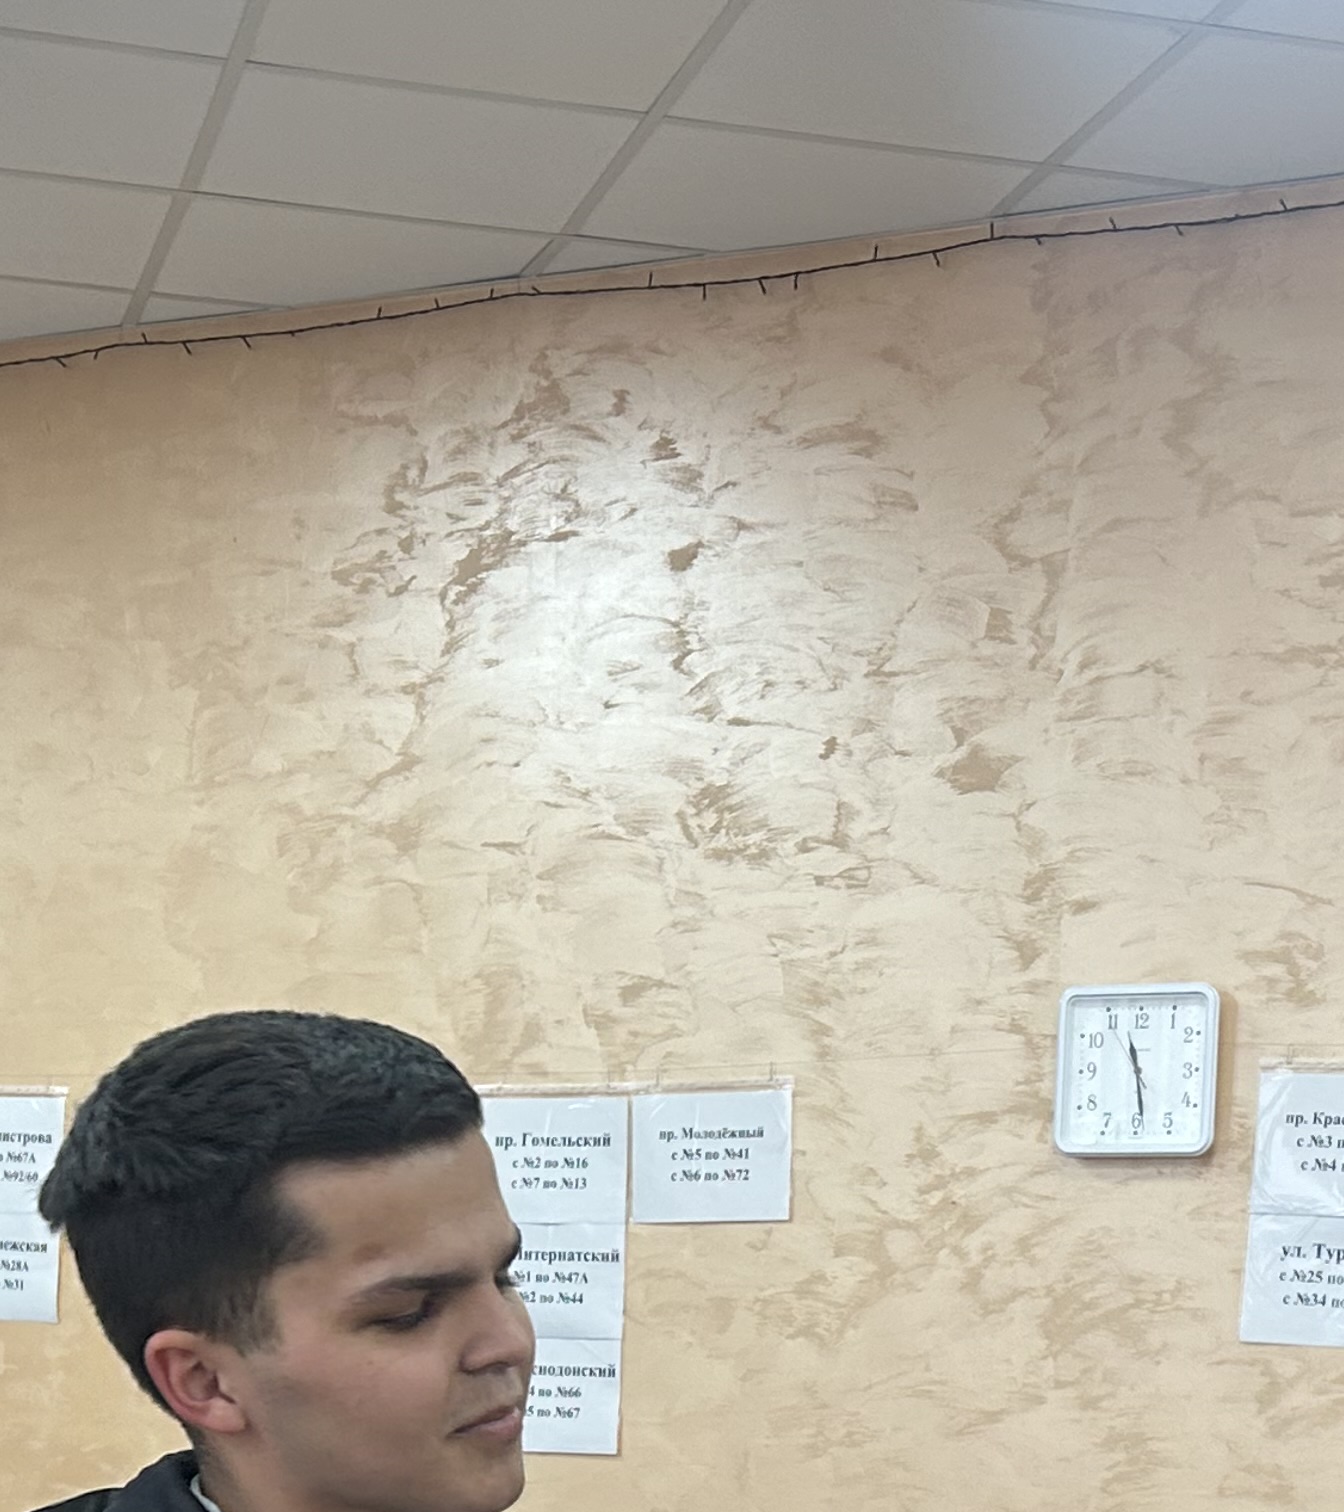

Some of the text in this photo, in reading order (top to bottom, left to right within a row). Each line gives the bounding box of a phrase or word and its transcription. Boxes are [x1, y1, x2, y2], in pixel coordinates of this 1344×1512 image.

[1108, 1014, 1117, 1030] 11
[1135, 1013, 1149, 1029] 12
[1170, 1012, 1175, 1029] 1
[1088, 1032, 1104, 1049] 10
[1184, 1027, 1193, 1043] 2
[1087, 1062, 1097, 1080] 9
[1183, 1063, 1192, 1079] 3
[1087, 1095, 1097, 1111] 8
[1182, 1092, 1191, 1107] 4
[1103, 1113, 1111, 1128] 7
[1132, 1113, 1141, 1128] 6
[1163, 1112, 1173, 1128] 5
[1286, 1114, 1308, 1128] пр.
[495, 1132, 611, 1151] пр. Гомельский
[659, 1126, 763, 1142] пр. Молодёжный
[1307, 1135, 1332, 1148] №3
[680, 1148, 702, 1160] №5
[705, 1151, 719, 1160] по
[722, 1148, 749, 1160] №41
[521, 1157, 541, 1168] №2
[544, 1160, 558, 1168] по
[561, 1157, 589, 1169] №16
[1311, 1158, 1336, 1171] №4
[721, 1169, 749, 1181] №72
[520, 1177, 540, 1189] №7
[543, 1180, 557, 1189] по
[560, 1177, 587, 1190] №13
[1280, 1246, 1306, 1261] ул.
[1290, 1269, 1323, 1283] №25
[1327, 1275, 1344, 1285] по
[1293, 1292, 1326, 1306] №34
[531, 1363, 615, 1378] снодонский
